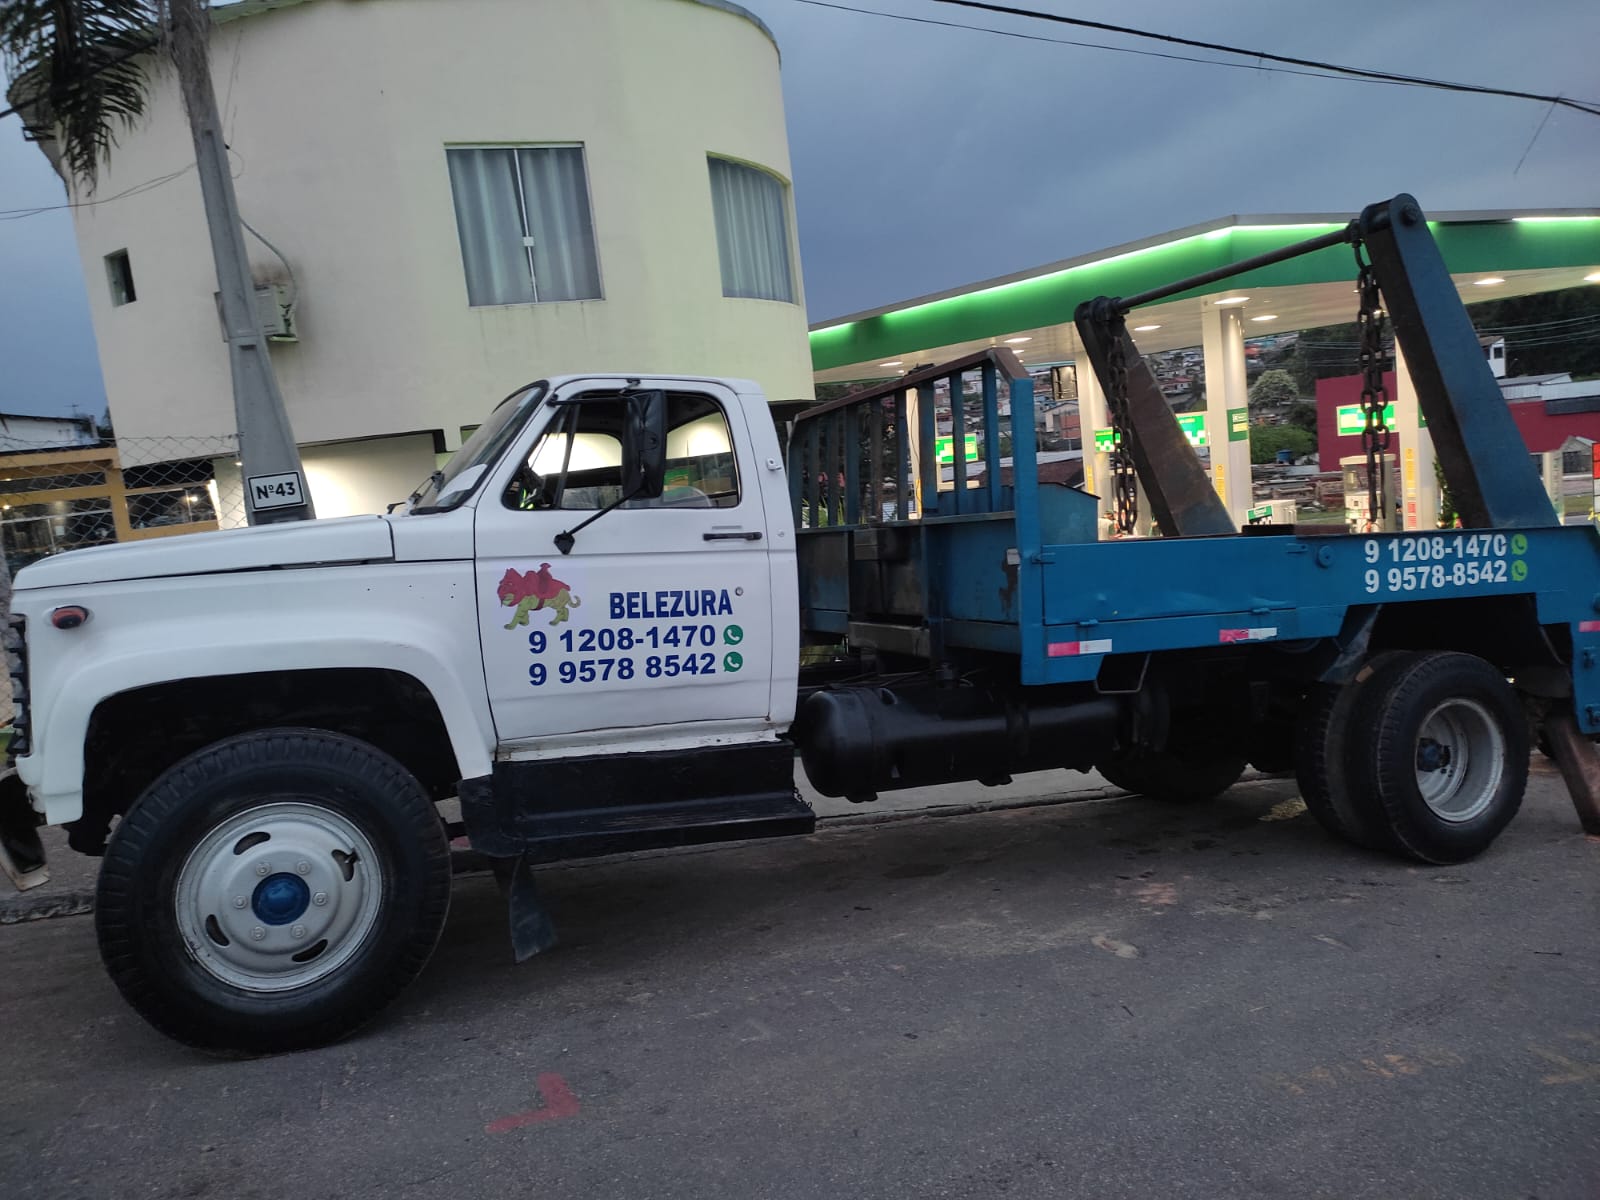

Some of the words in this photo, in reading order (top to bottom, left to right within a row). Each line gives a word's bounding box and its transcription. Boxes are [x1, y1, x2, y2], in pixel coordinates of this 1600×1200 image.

[1364, 539, 1380, 563] 9
[1388, 533, 1507, 562] 1208-1470
[1364, 569, 1380, 593] 9
[1387, 559, 1508, 592] 9578-8542
[609, 588, 733, 620] BELEZURA
[528, 630, 547, 654] 9
[559, 624, 717, 653] 1208-1470
[528, 662, 547, 686] 9
[558, 657, 634, 684] 9578
[645, 652, 717, 678] 8542
